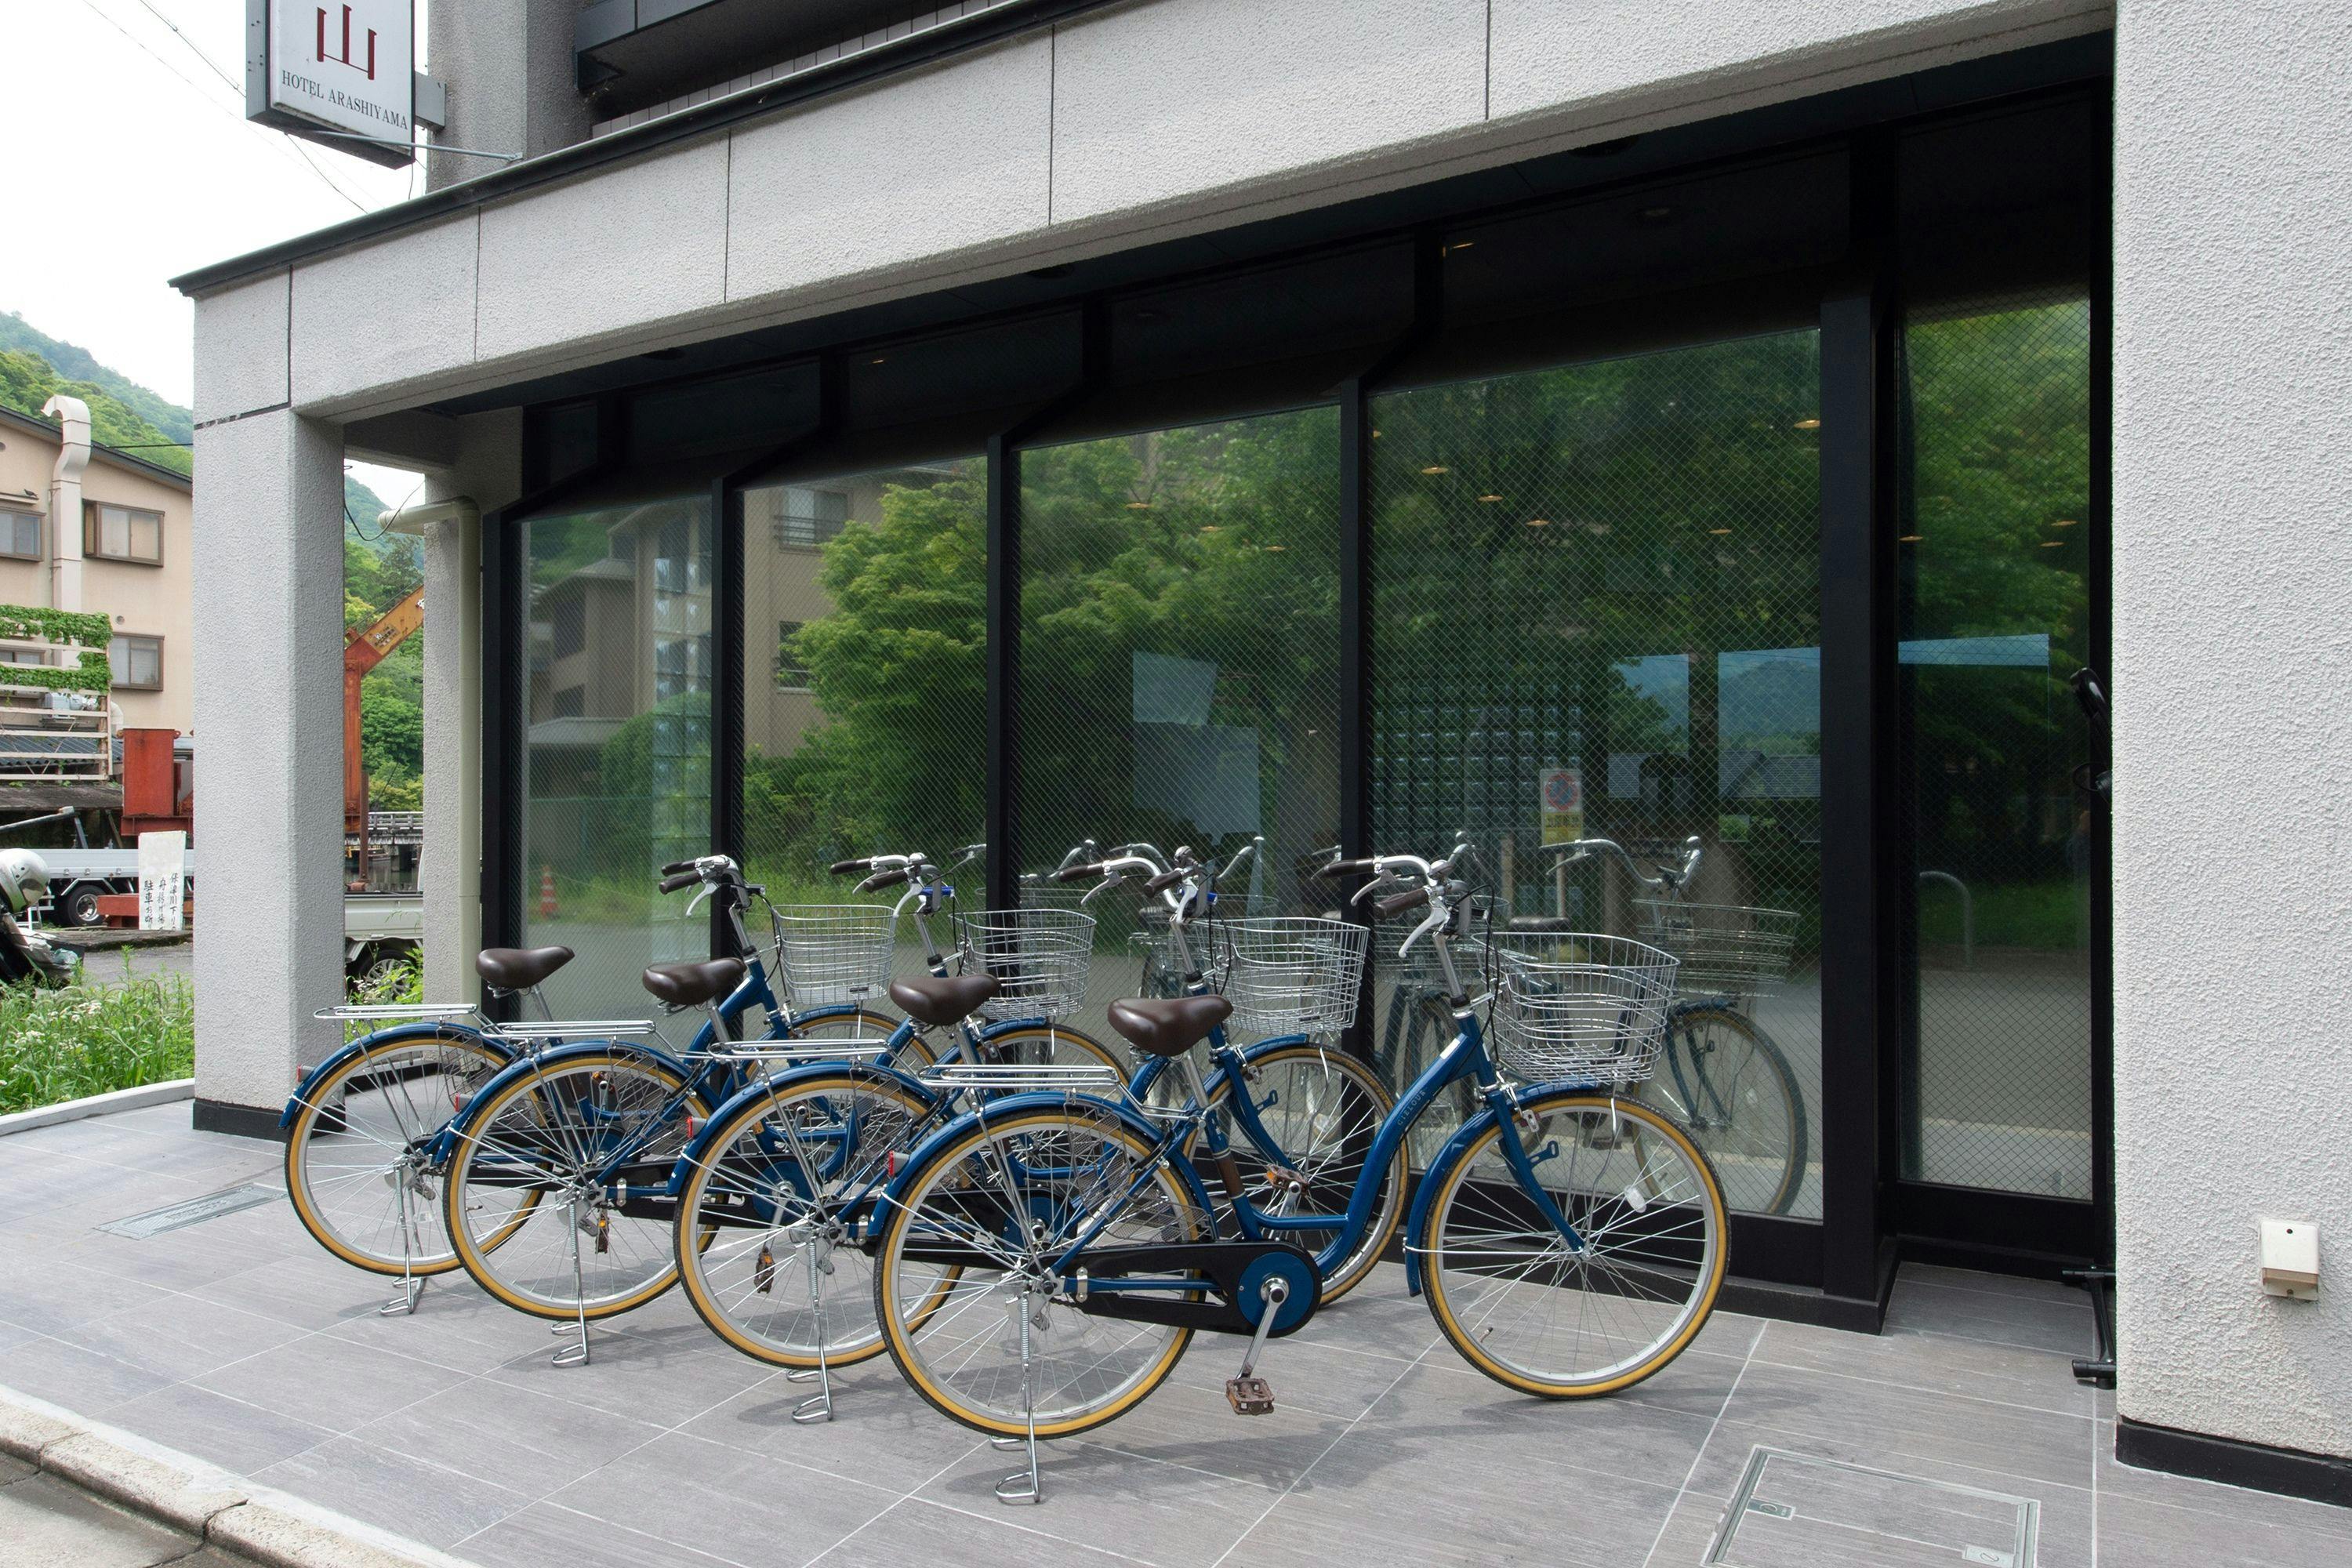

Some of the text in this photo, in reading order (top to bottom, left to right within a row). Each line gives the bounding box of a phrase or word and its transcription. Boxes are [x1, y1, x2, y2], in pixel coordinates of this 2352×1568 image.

[281, 69, 408, 130] HOTEL ARASHIYAMA
[1143, 1055, 1165, 1084] CIELOU
